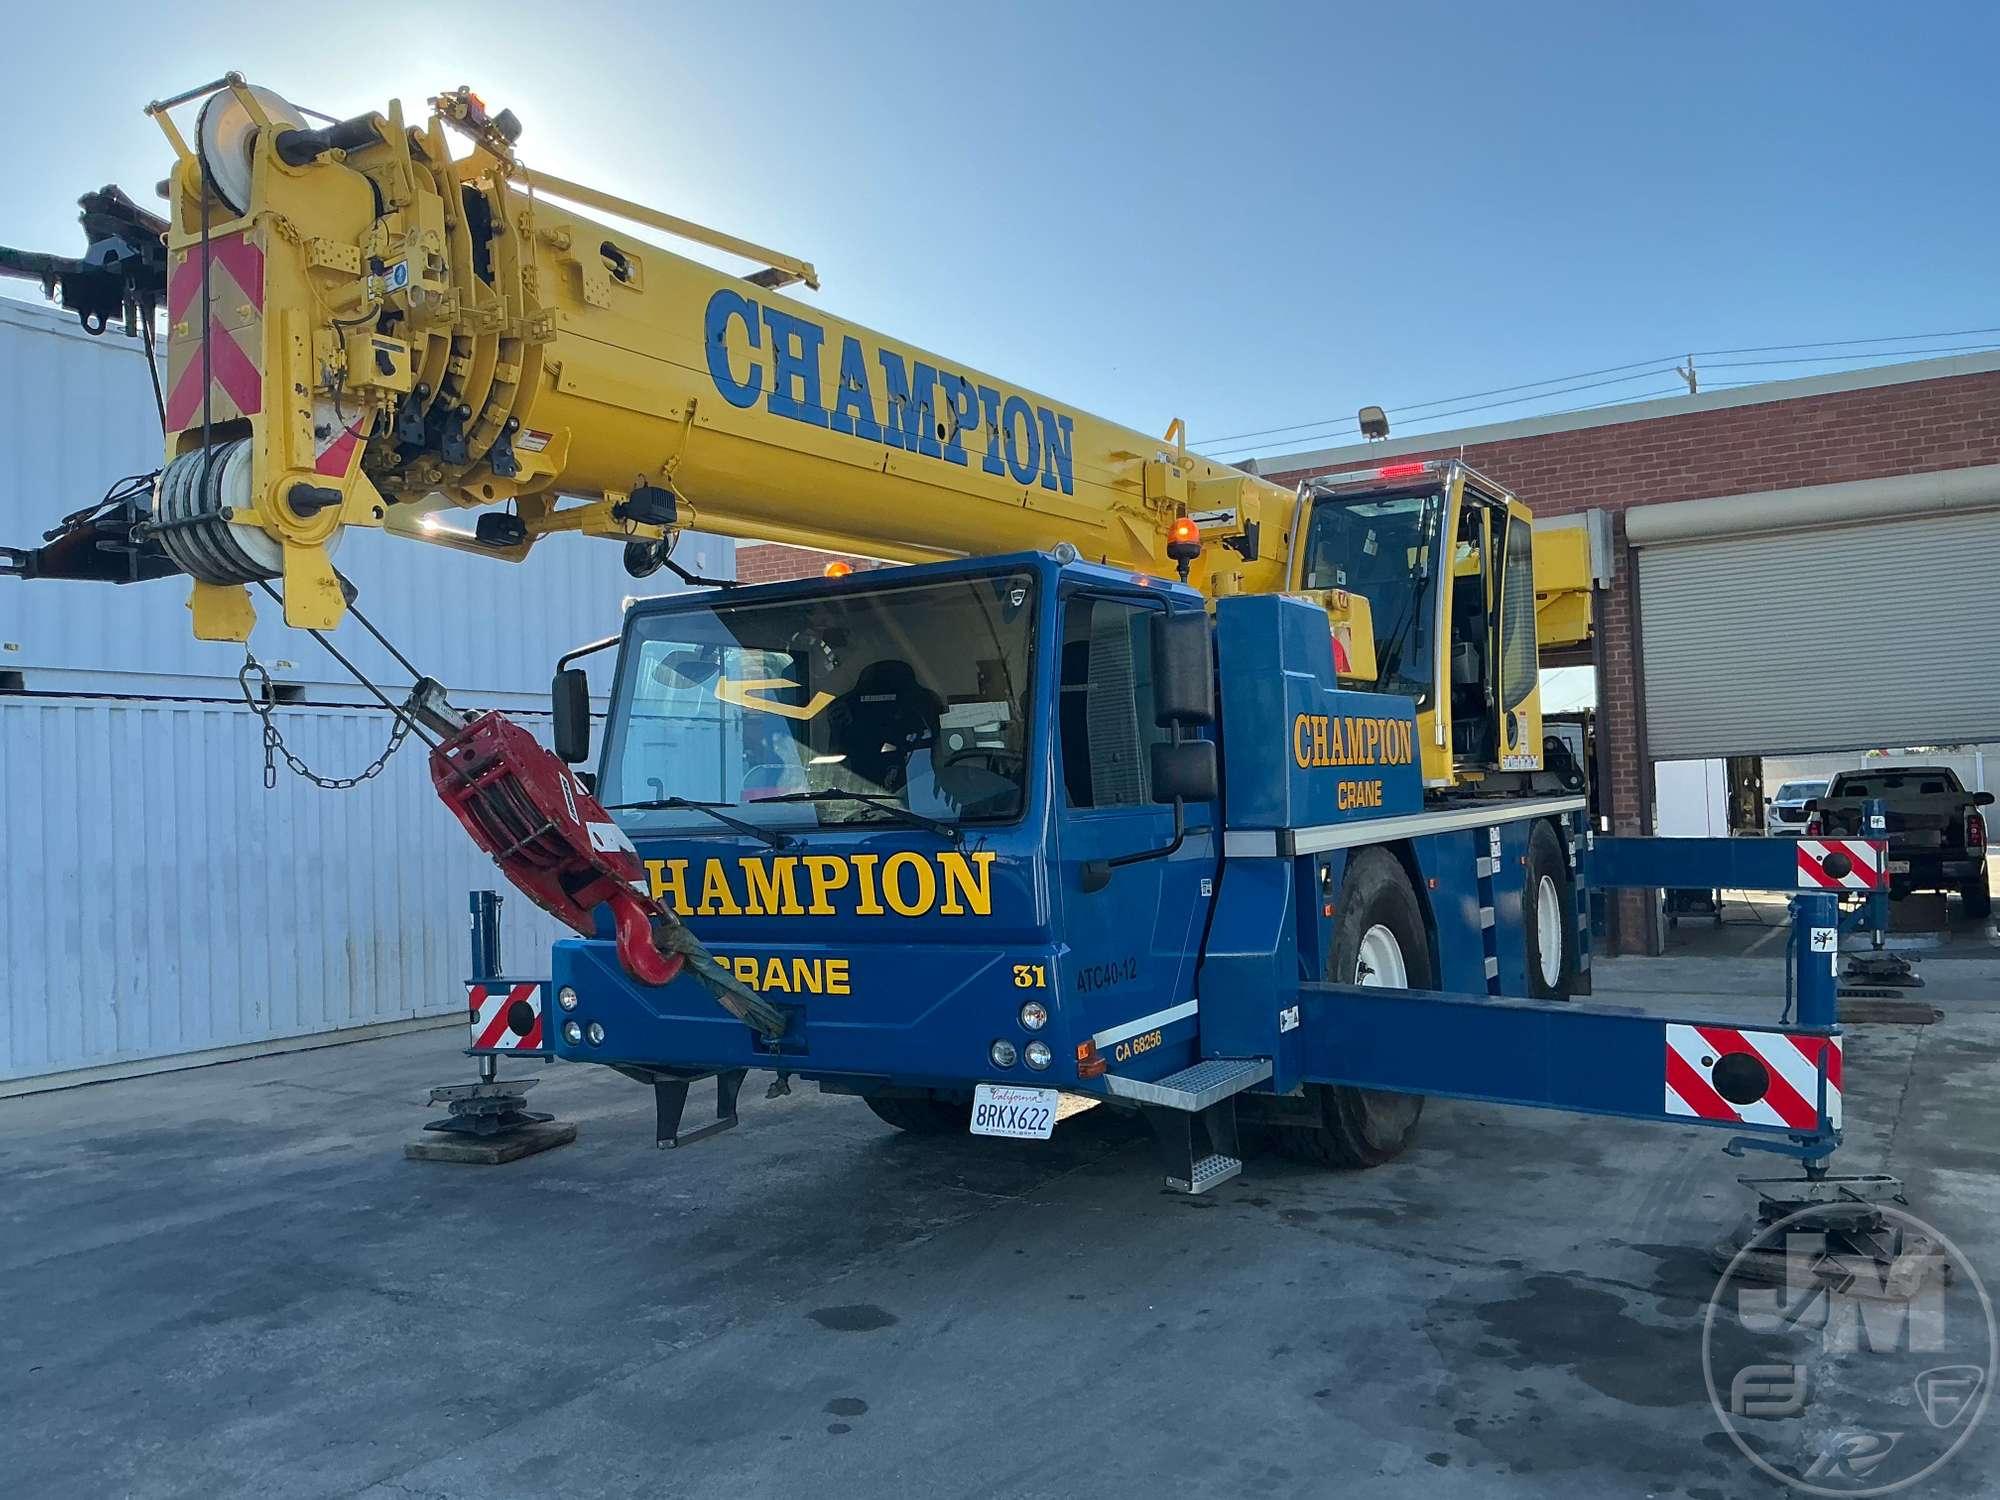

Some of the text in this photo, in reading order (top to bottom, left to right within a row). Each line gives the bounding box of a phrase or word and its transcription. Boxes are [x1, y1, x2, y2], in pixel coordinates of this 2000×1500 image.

[704, 288, 1074, 496] CHAMPION
[1293, 712, 1412, 769] CHAMPION
[1337, 779, 1382, 810] CRANE
[643, 850, 996, 917] HAMPION
[1013, 964, 1047, 988] 31
[1077, 957, 1137, 993] ATC40-12
[1115, 1029, 1162, 1062] CA 68256
[991, 1087, 1042, 1104] California
[976, 1103, 1050, 1131] 8RKX622
